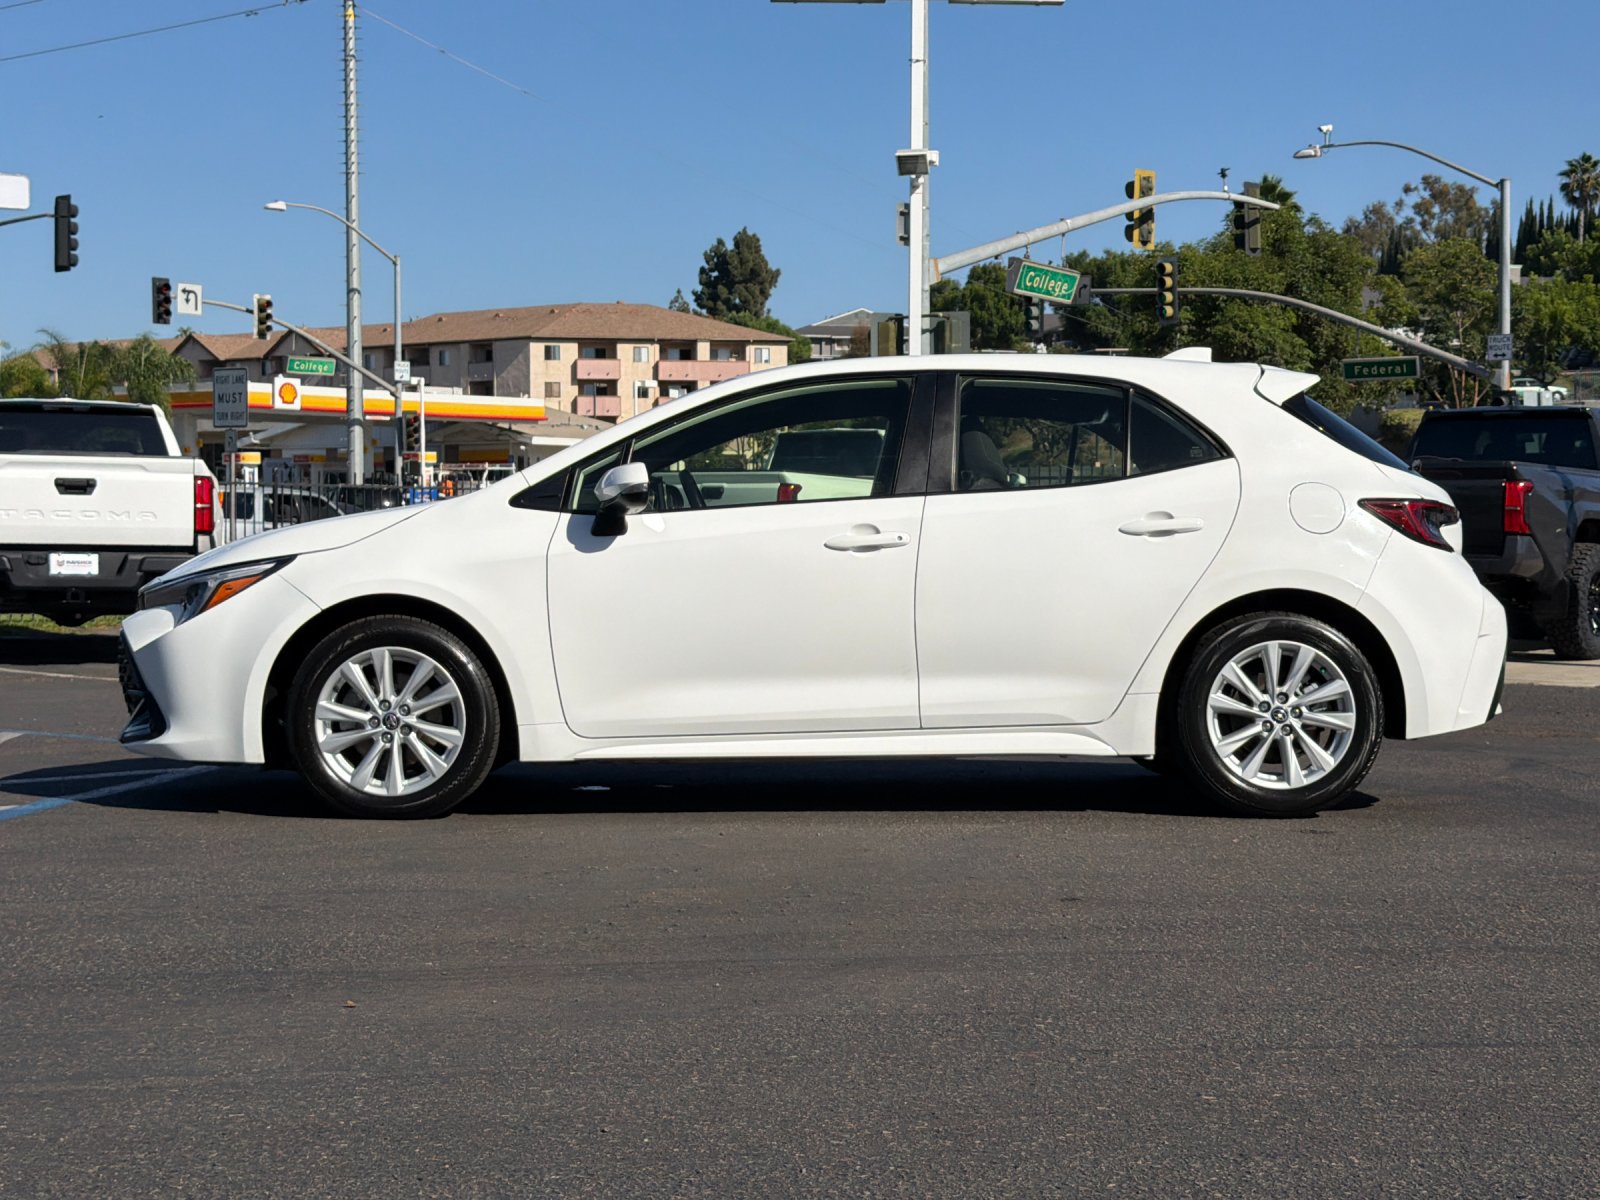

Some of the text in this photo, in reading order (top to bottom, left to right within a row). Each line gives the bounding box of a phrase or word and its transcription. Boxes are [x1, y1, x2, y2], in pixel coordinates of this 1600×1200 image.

[1026, 271, 1069, 297] College
[1489, 343, 1511, 351] ROUTE
[293, 361, 329, 373] College
[1354, 363, 1407, 376] Federal
[215, 374, 245, 384] RIGHT LANE
[218, 392, 243, 404] MUST
[216, 411, 245, 421] TURN RIGHT
[0, 508, 158, 521] TACOMA
